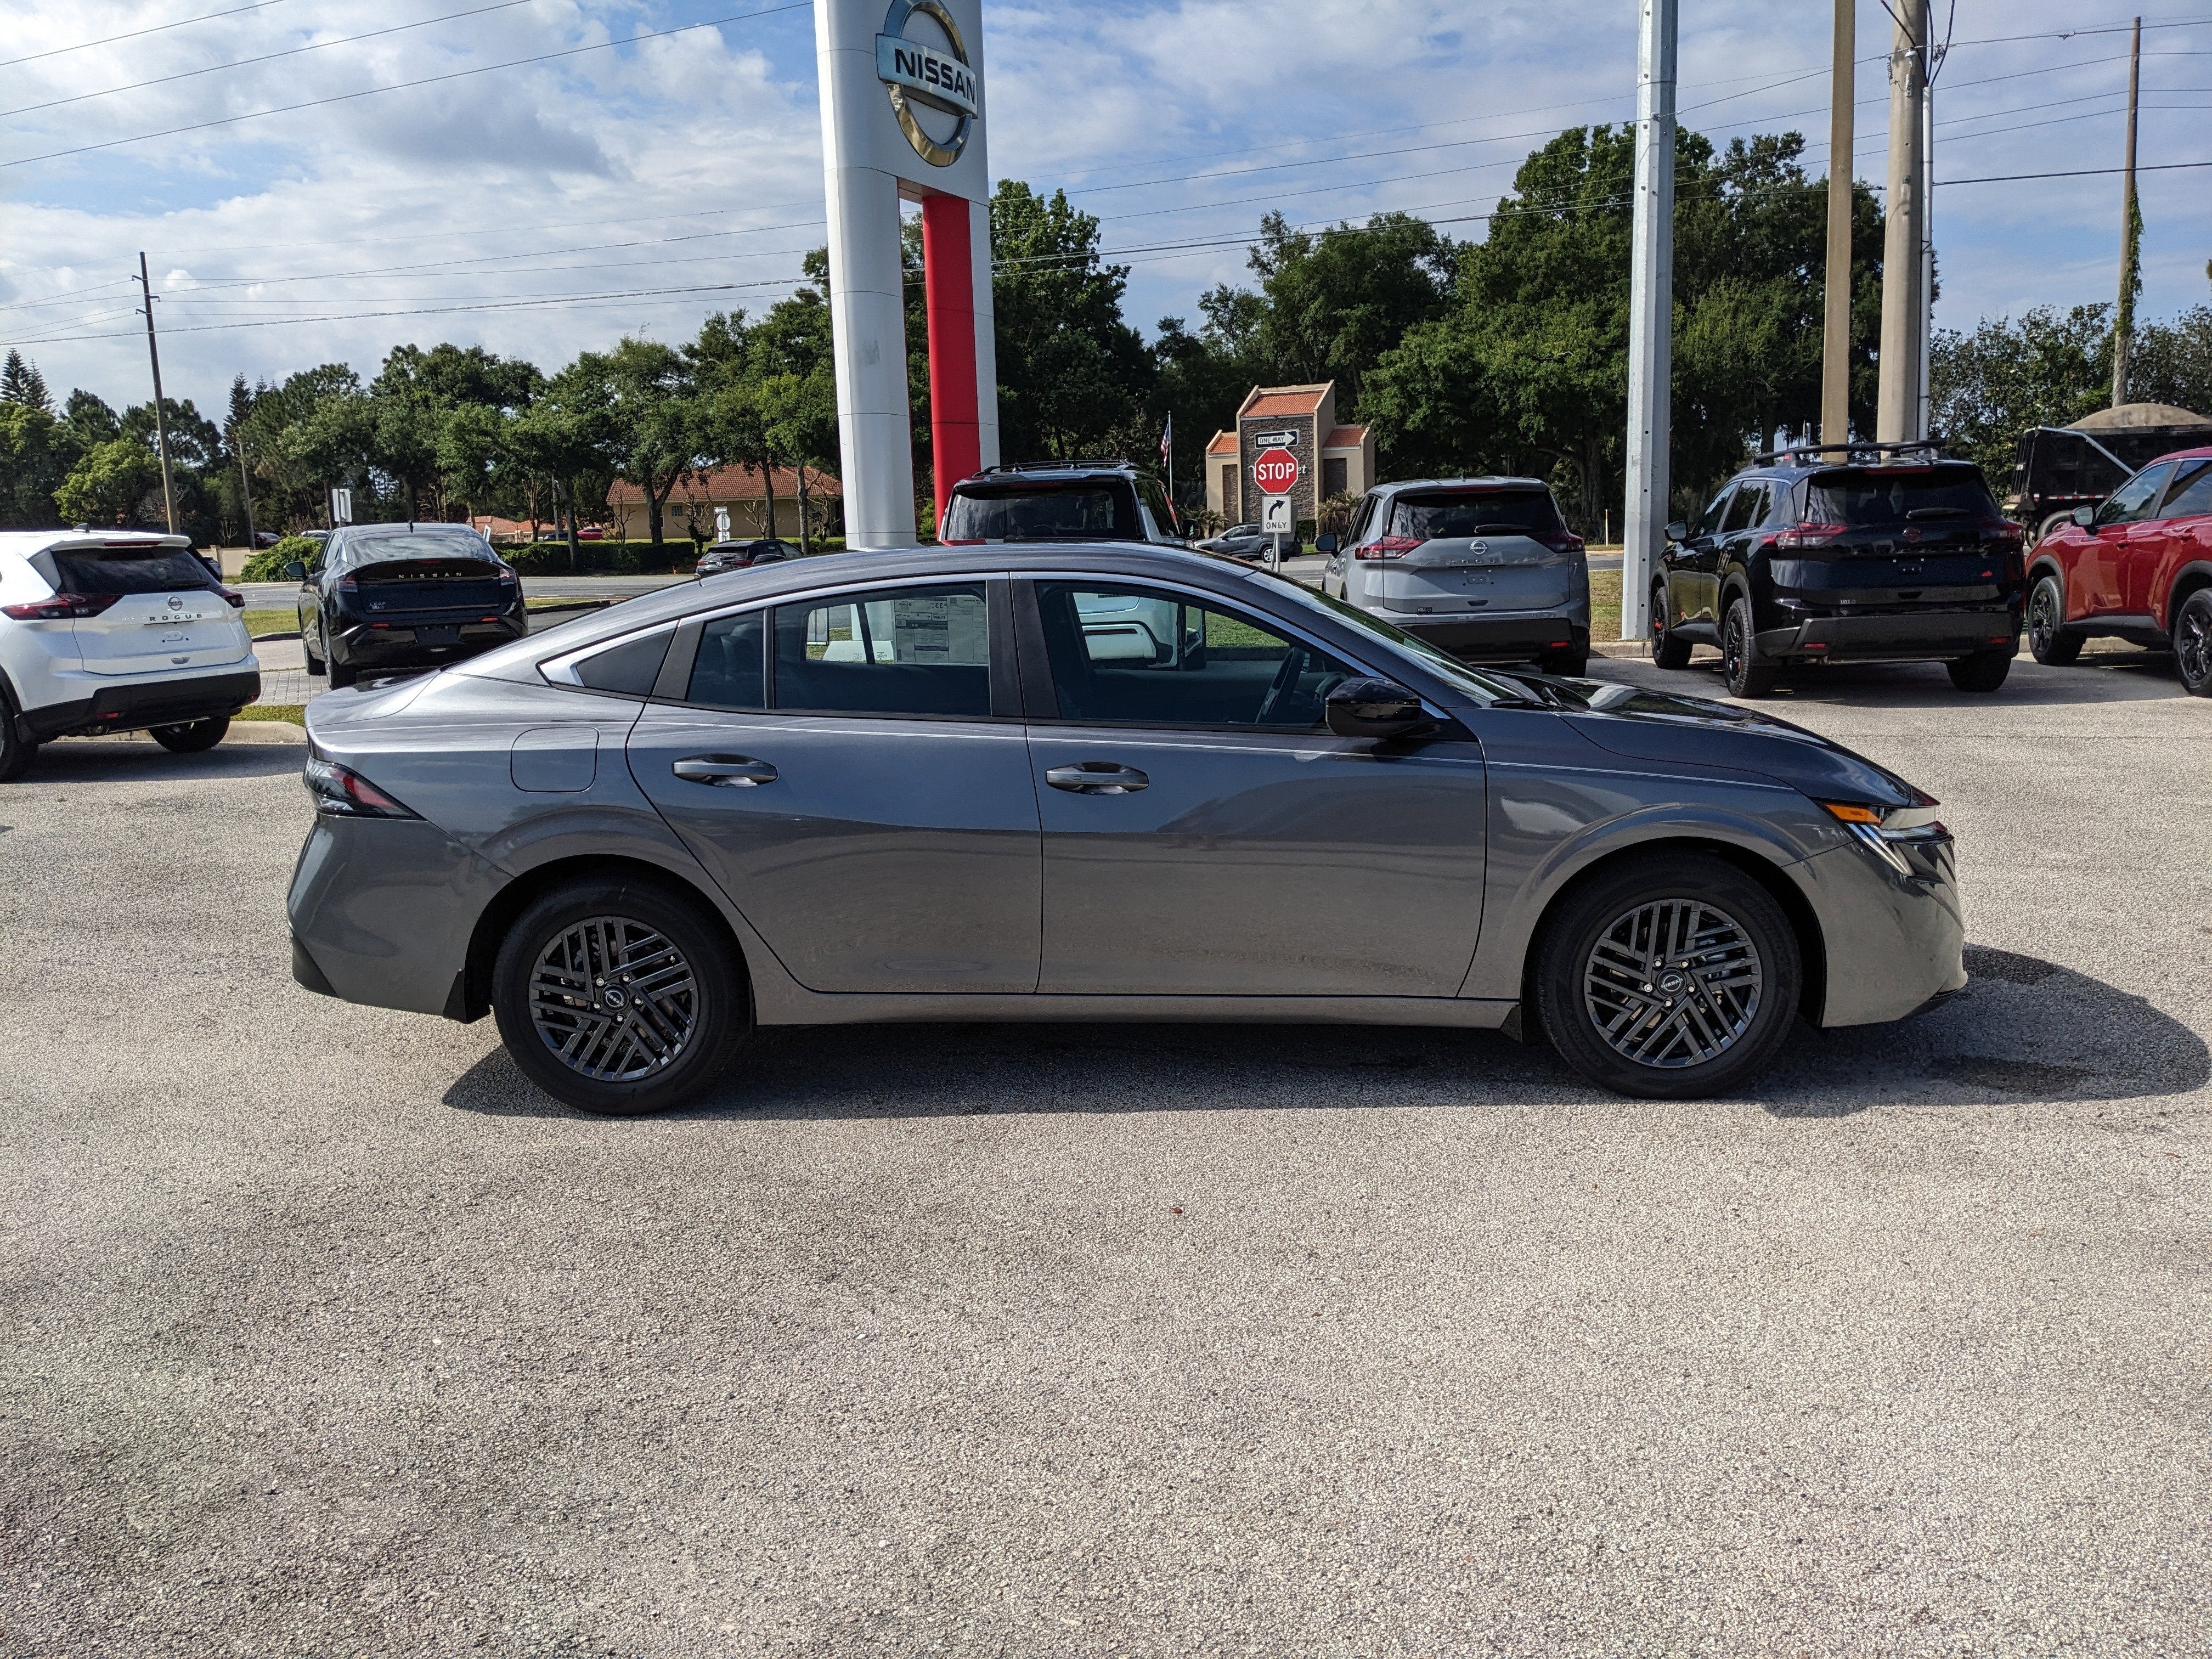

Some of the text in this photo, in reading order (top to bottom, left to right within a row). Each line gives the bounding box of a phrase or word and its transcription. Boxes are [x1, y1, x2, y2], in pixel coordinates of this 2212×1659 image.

[894, 47, 976, 105] NISSAN
[1258, 462, 1295, 481] STOP
[1266, 521, 1287, 529] ONLY
[149, 613, 202, 622] ROGUE
[1661, 977, 1683, 989] NISSAN
